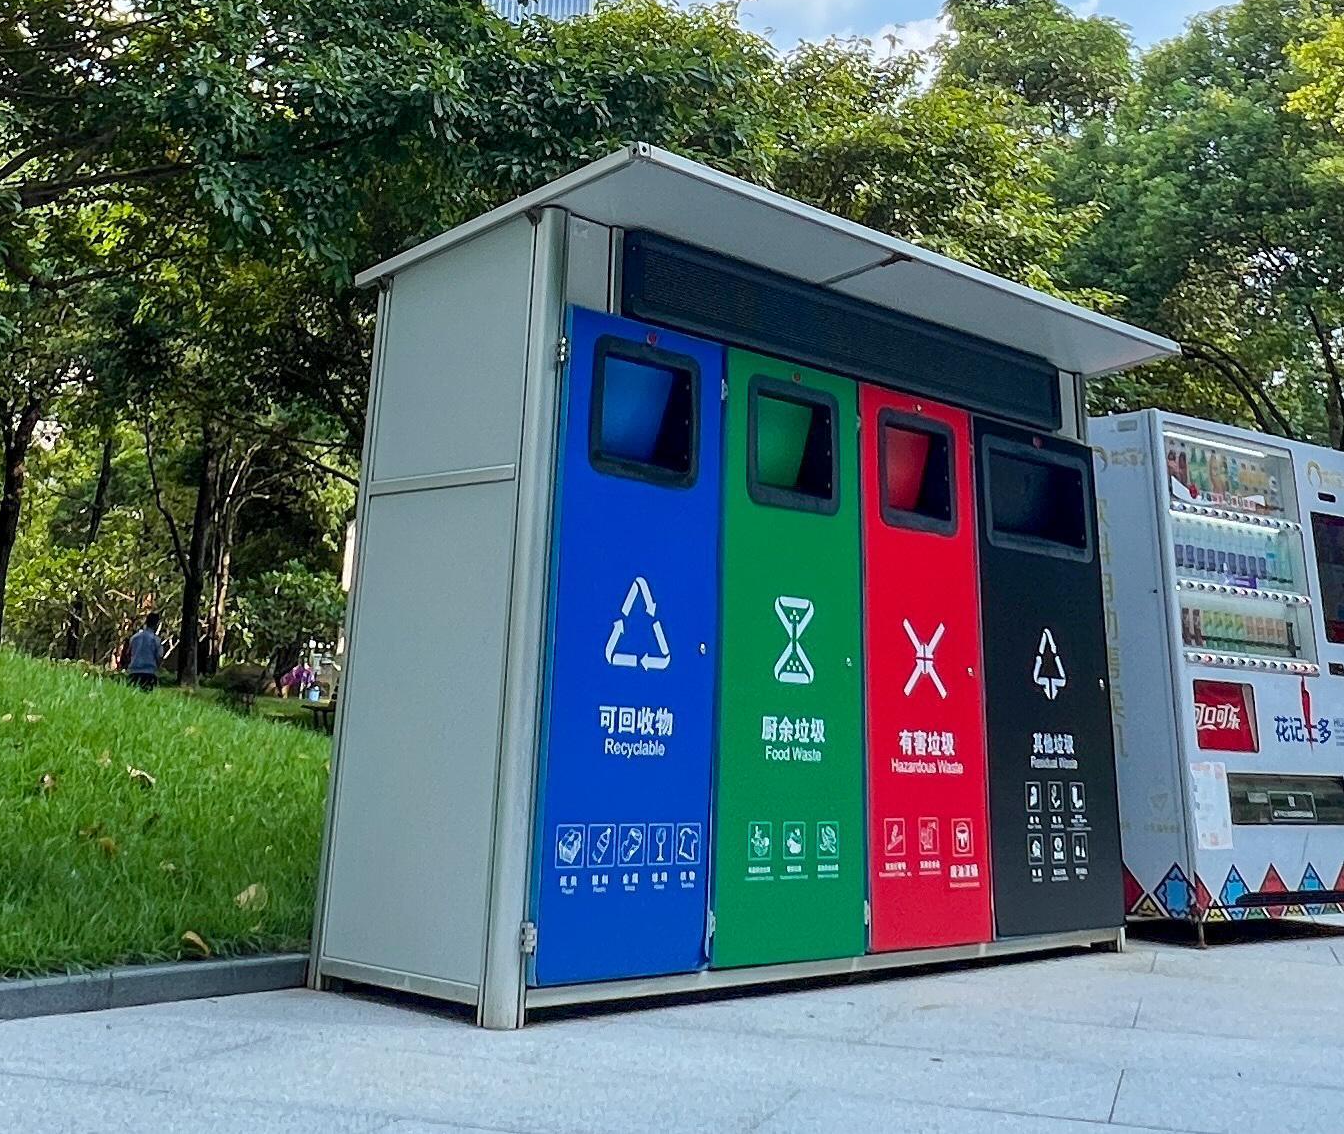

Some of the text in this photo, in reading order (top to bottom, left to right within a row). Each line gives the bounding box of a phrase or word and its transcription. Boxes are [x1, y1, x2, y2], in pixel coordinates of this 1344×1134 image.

[599, 705, 673, 736] 可回收物
[1193, 703, 1240, 730] 可口可乐
[761, 716, 825, 743] 厨余垃圾
[605, 738, 665, 758] Recyclable
[765, 745, 821, 762] Food Waste
[899, 729, 955, 756] 有害垃圾
[1033, 732, 1074, 754] 其他垃圾
[891, 758, 963, 774] Hazardous Waste
